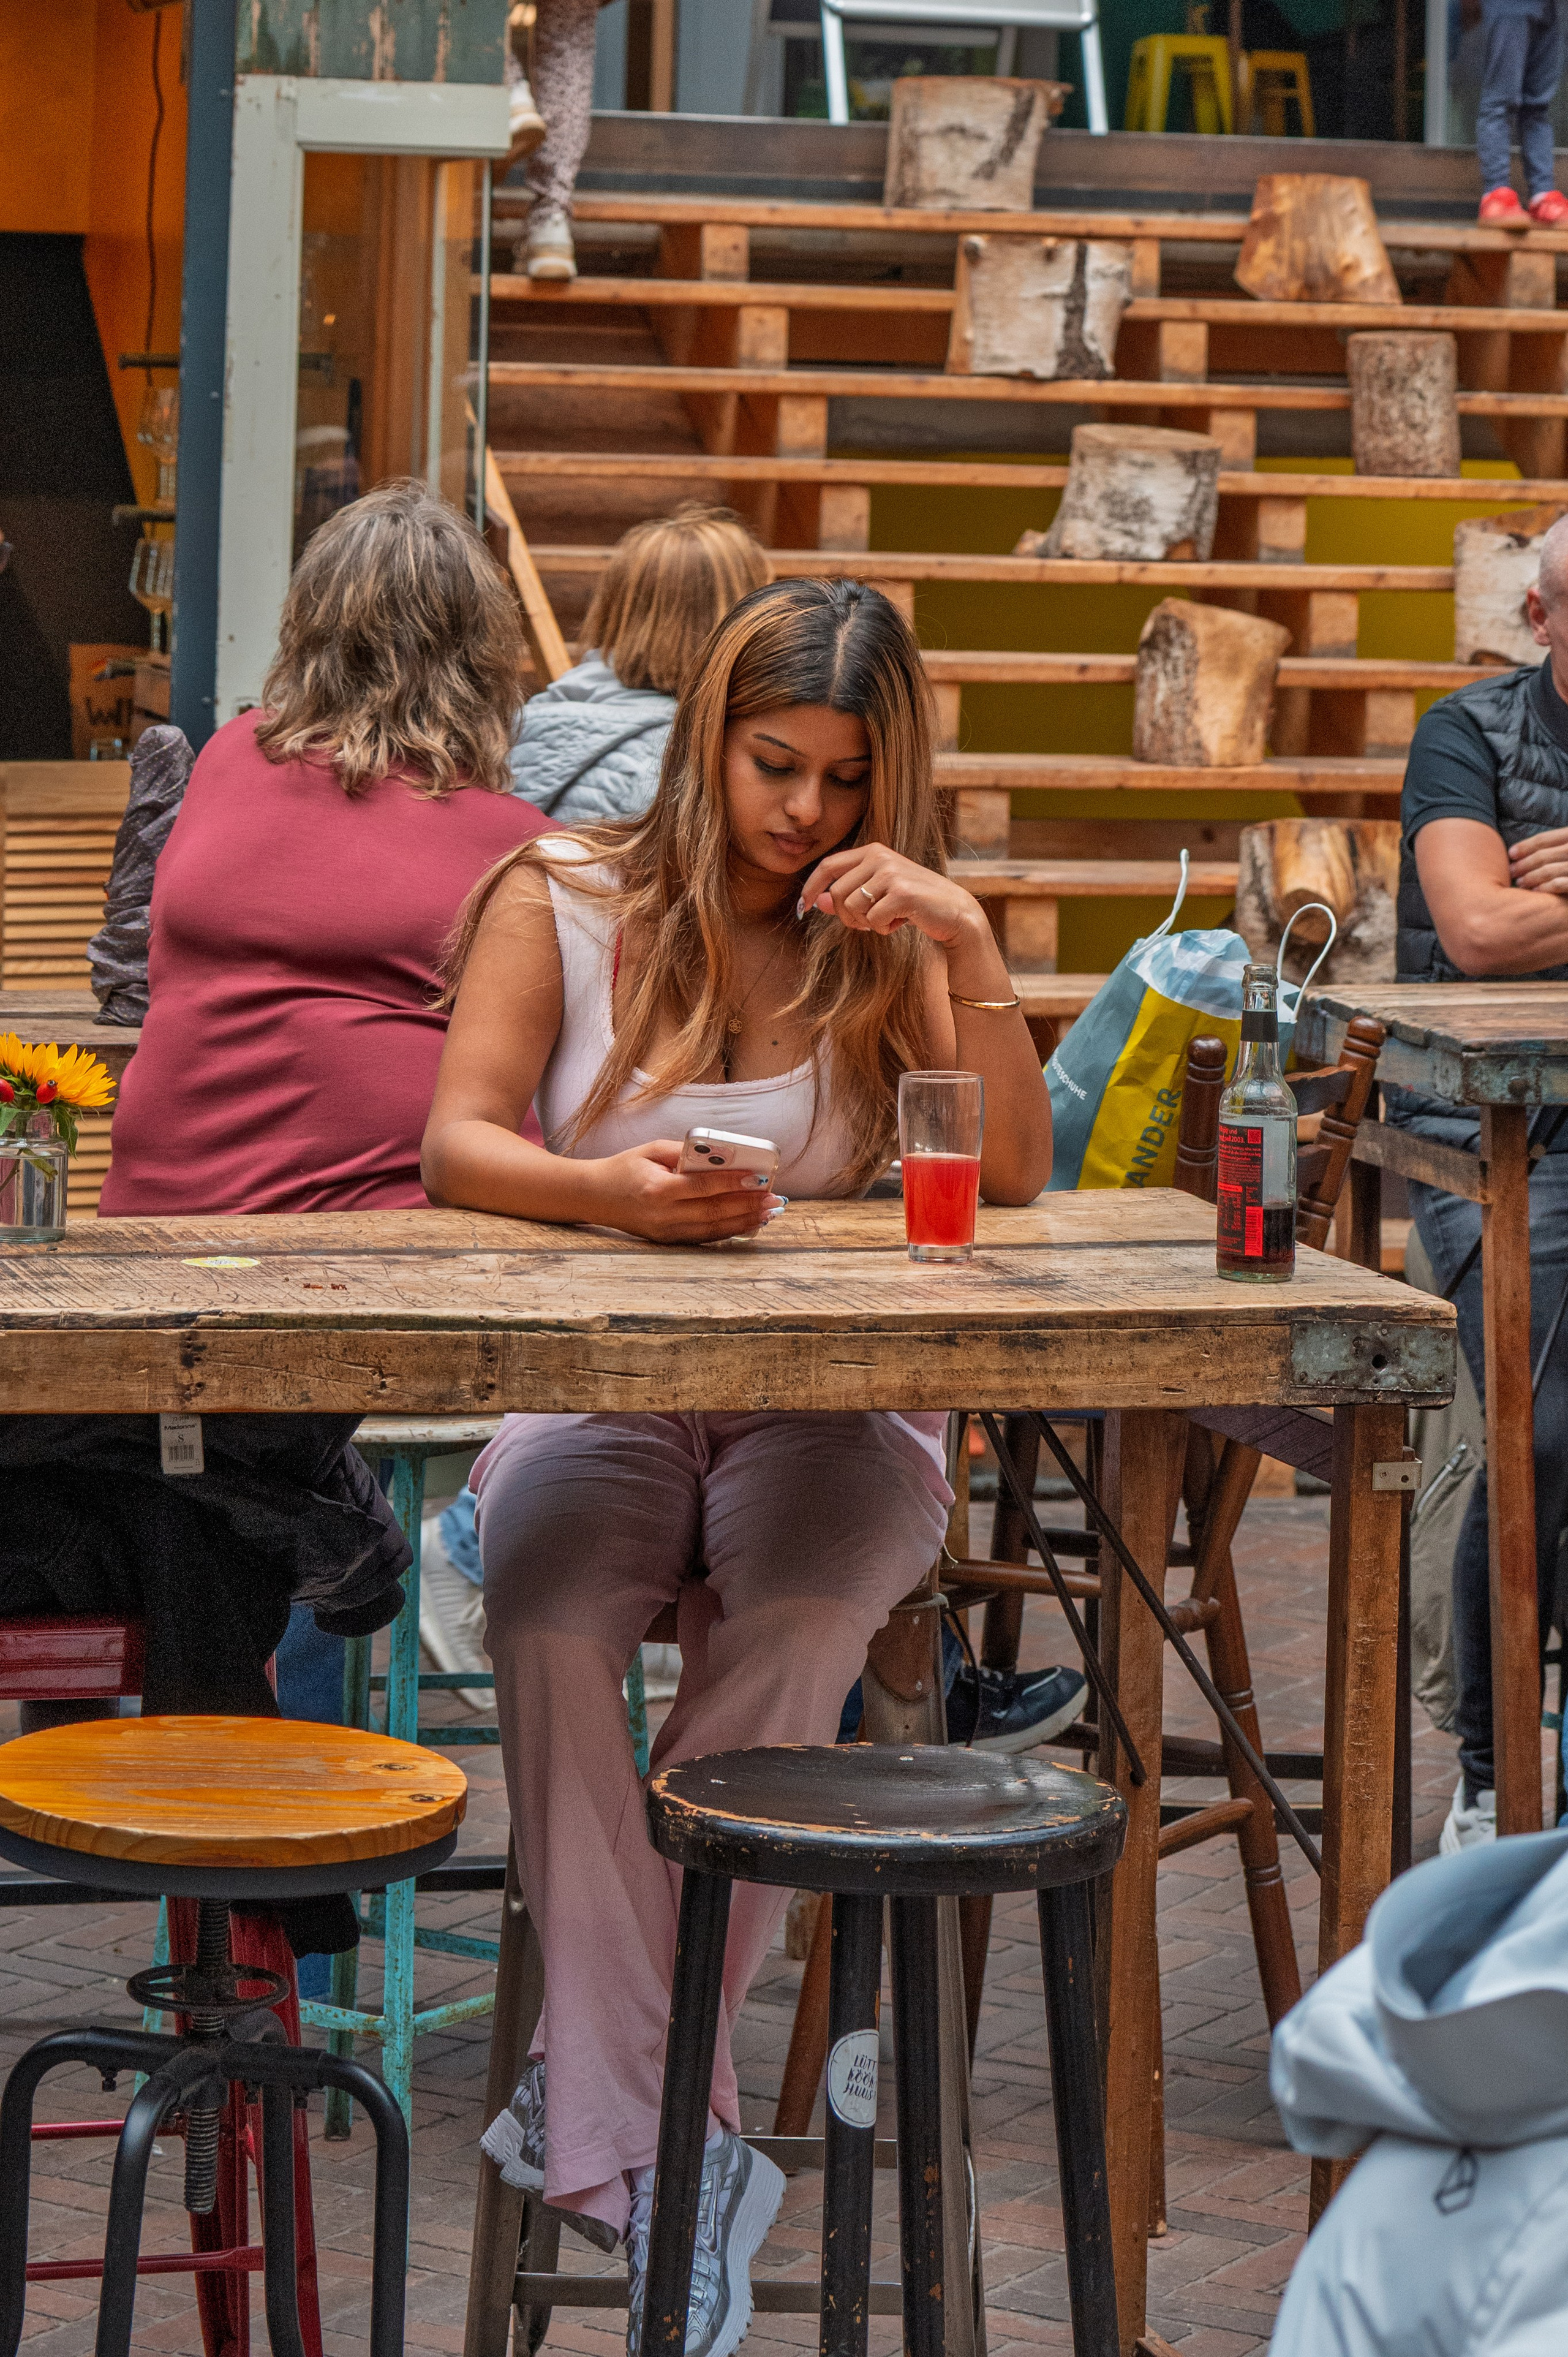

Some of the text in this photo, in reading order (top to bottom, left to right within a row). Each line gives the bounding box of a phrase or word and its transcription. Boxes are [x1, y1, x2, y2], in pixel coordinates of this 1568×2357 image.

[1125, 1088, 1182, 1188] ANDER
[178, 1434, 184, 1443] S
[854, 2054, 876, 2072] LÜTT
